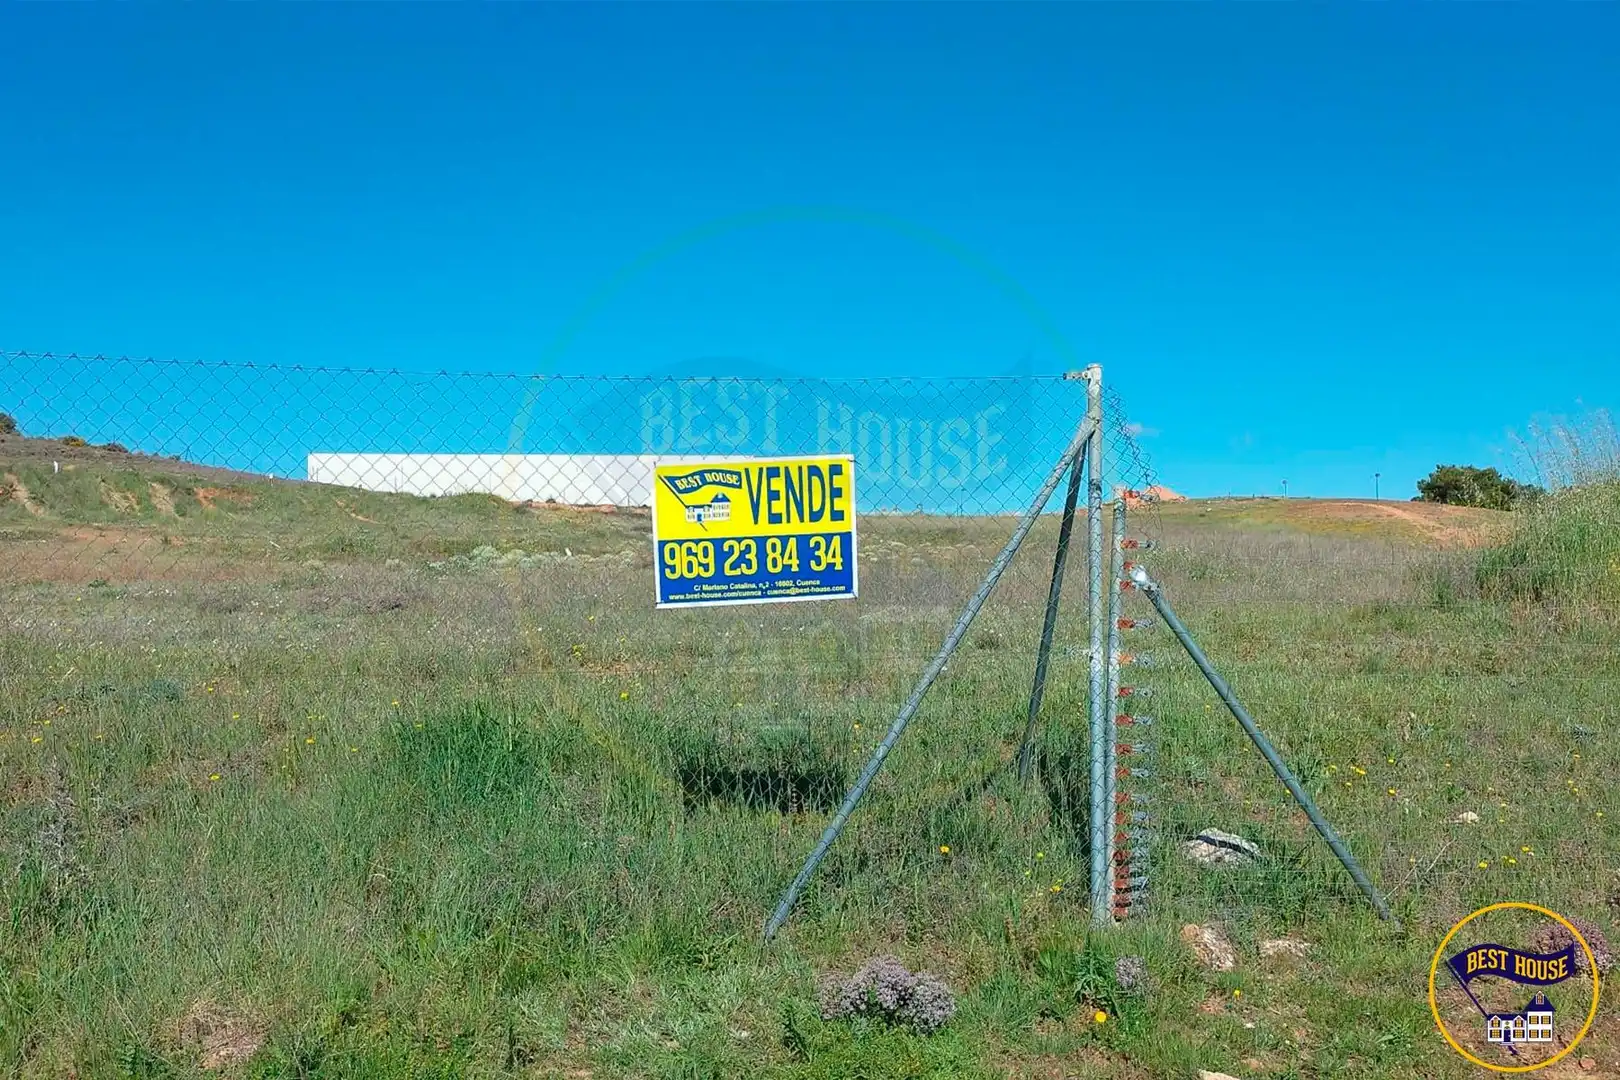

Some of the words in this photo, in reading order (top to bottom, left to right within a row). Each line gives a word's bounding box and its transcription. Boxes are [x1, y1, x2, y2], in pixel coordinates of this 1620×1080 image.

[675, 475, 702, 490] BEST
[704, 472, 740, 485] HOUSE
[744, 464, 845, 525] VENDE
[663, 540, 715, 580] 969
[723, 538, 758, 576] 23
[766, 537, 799, 574] 84
[809, 535, 843, 571] 34
[669, 590, 761, 600] www.best-house.com/cuenca
[767, 586, 846, 596] cuenca@best-house.com
